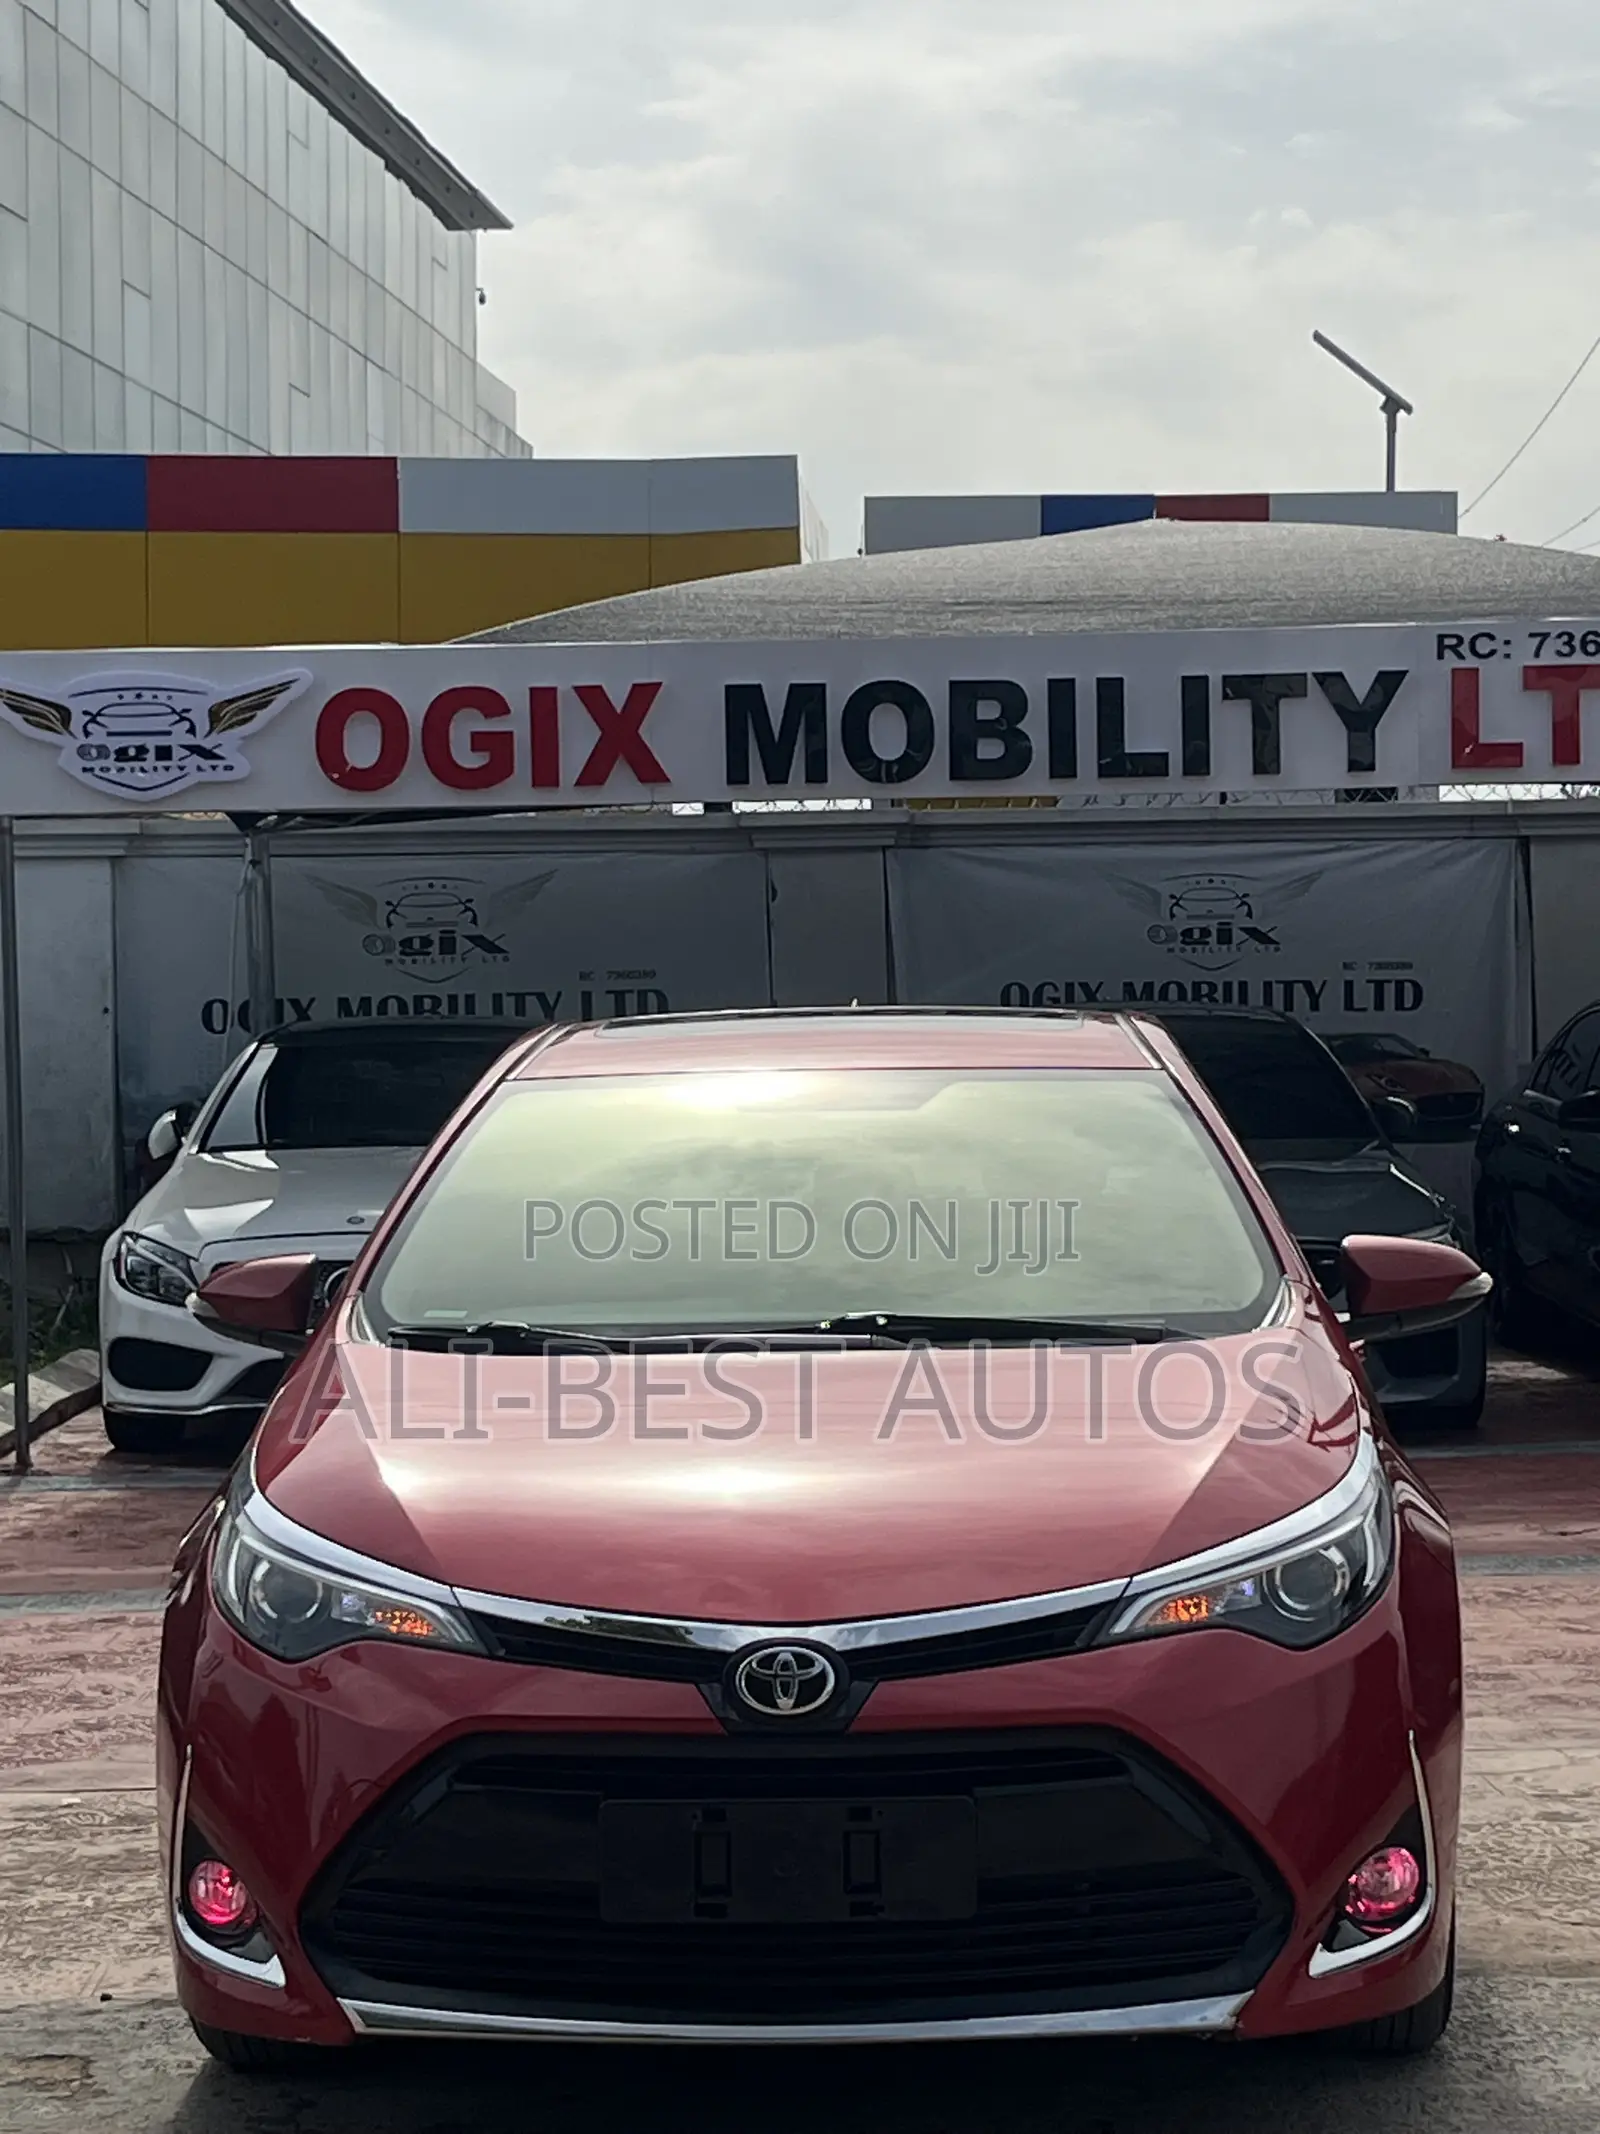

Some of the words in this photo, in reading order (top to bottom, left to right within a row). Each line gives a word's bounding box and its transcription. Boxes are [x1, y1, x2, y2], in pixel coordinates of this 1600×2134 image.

[1436, 632, 1512, 661] RC:
[315, 681, 671, 792] OGIX
[725, 669, 1409, 786] MOBILITY
[1450, 664, 1600, 769] LT
[1001, 981, 1104, 1007] OGIX
[1122, 979, 1328, 1012] MOBILITY
[1343, 978, 1423, 1012] LTD
